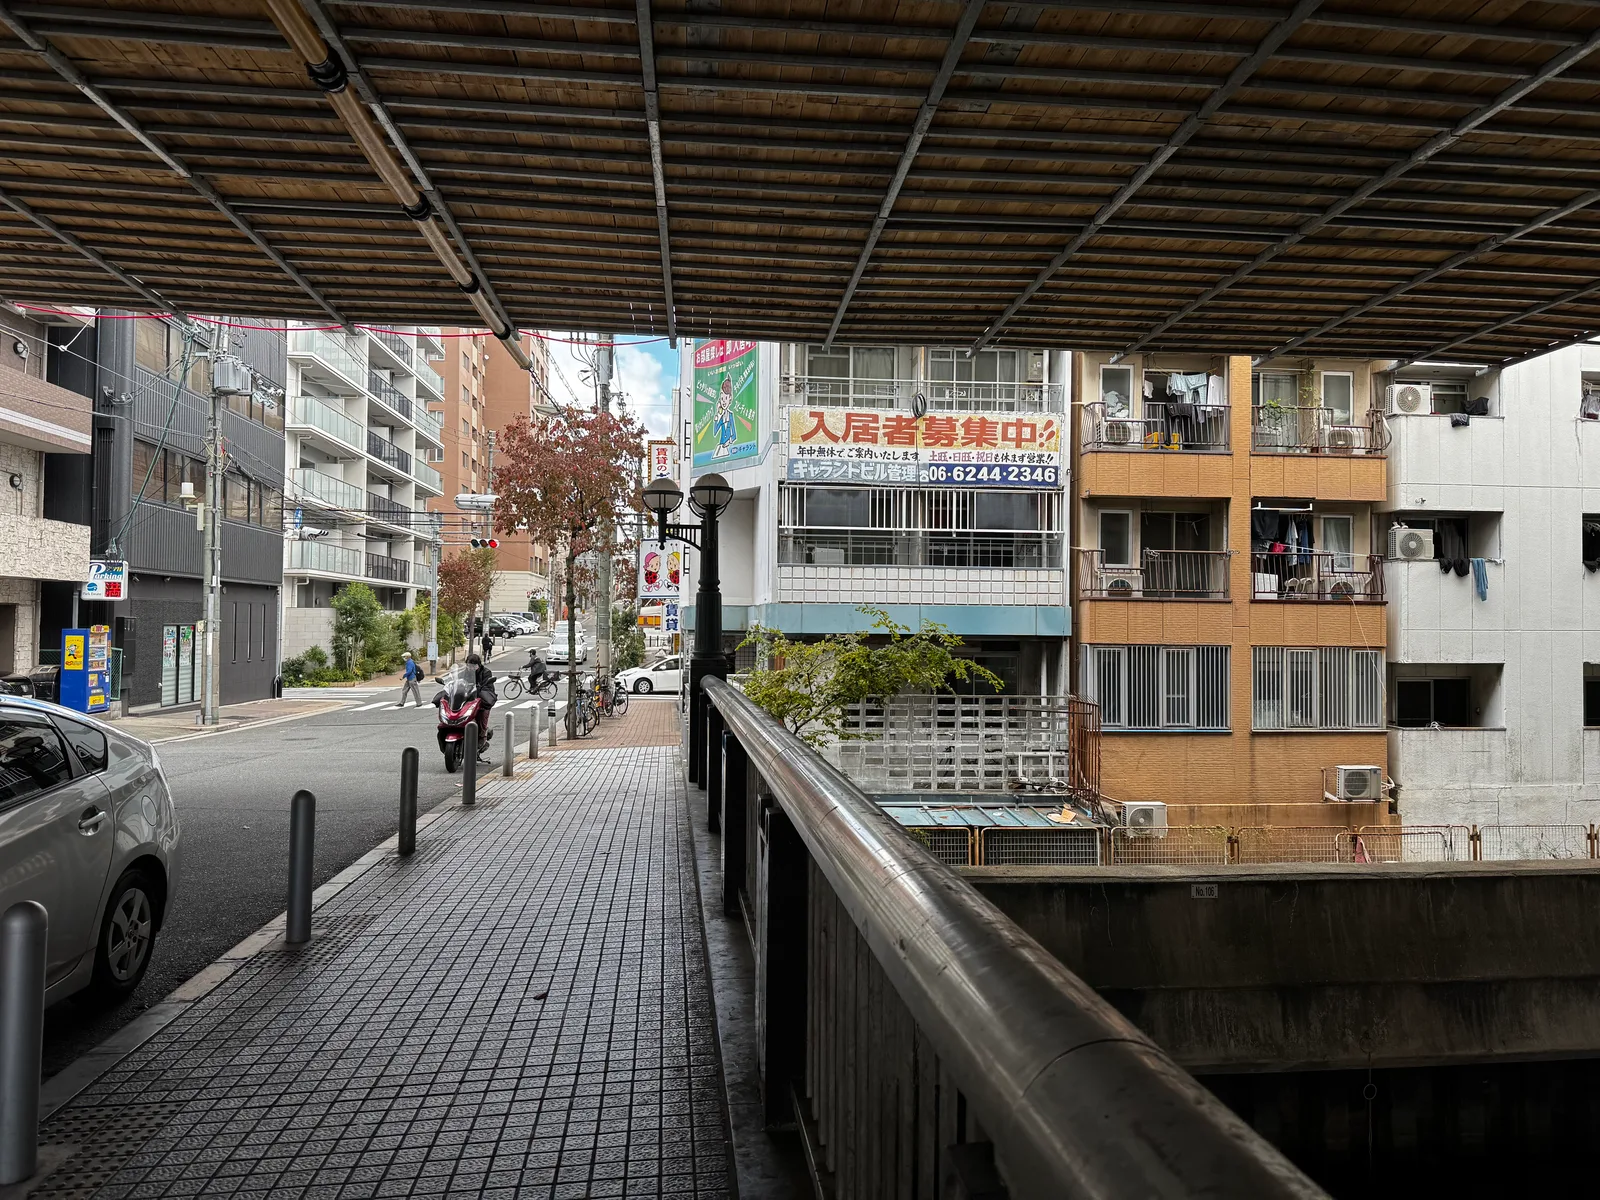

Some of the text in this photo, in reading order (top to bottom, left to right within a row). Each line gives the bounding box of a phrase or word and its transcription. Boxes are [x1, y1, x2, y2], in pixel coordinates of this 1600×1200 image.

[800, 411, 1056, 449] 入居者募集中!!
[793, 460, 917, 482] ギャラントビル管理
[89, 562, 122, 580] Parking
